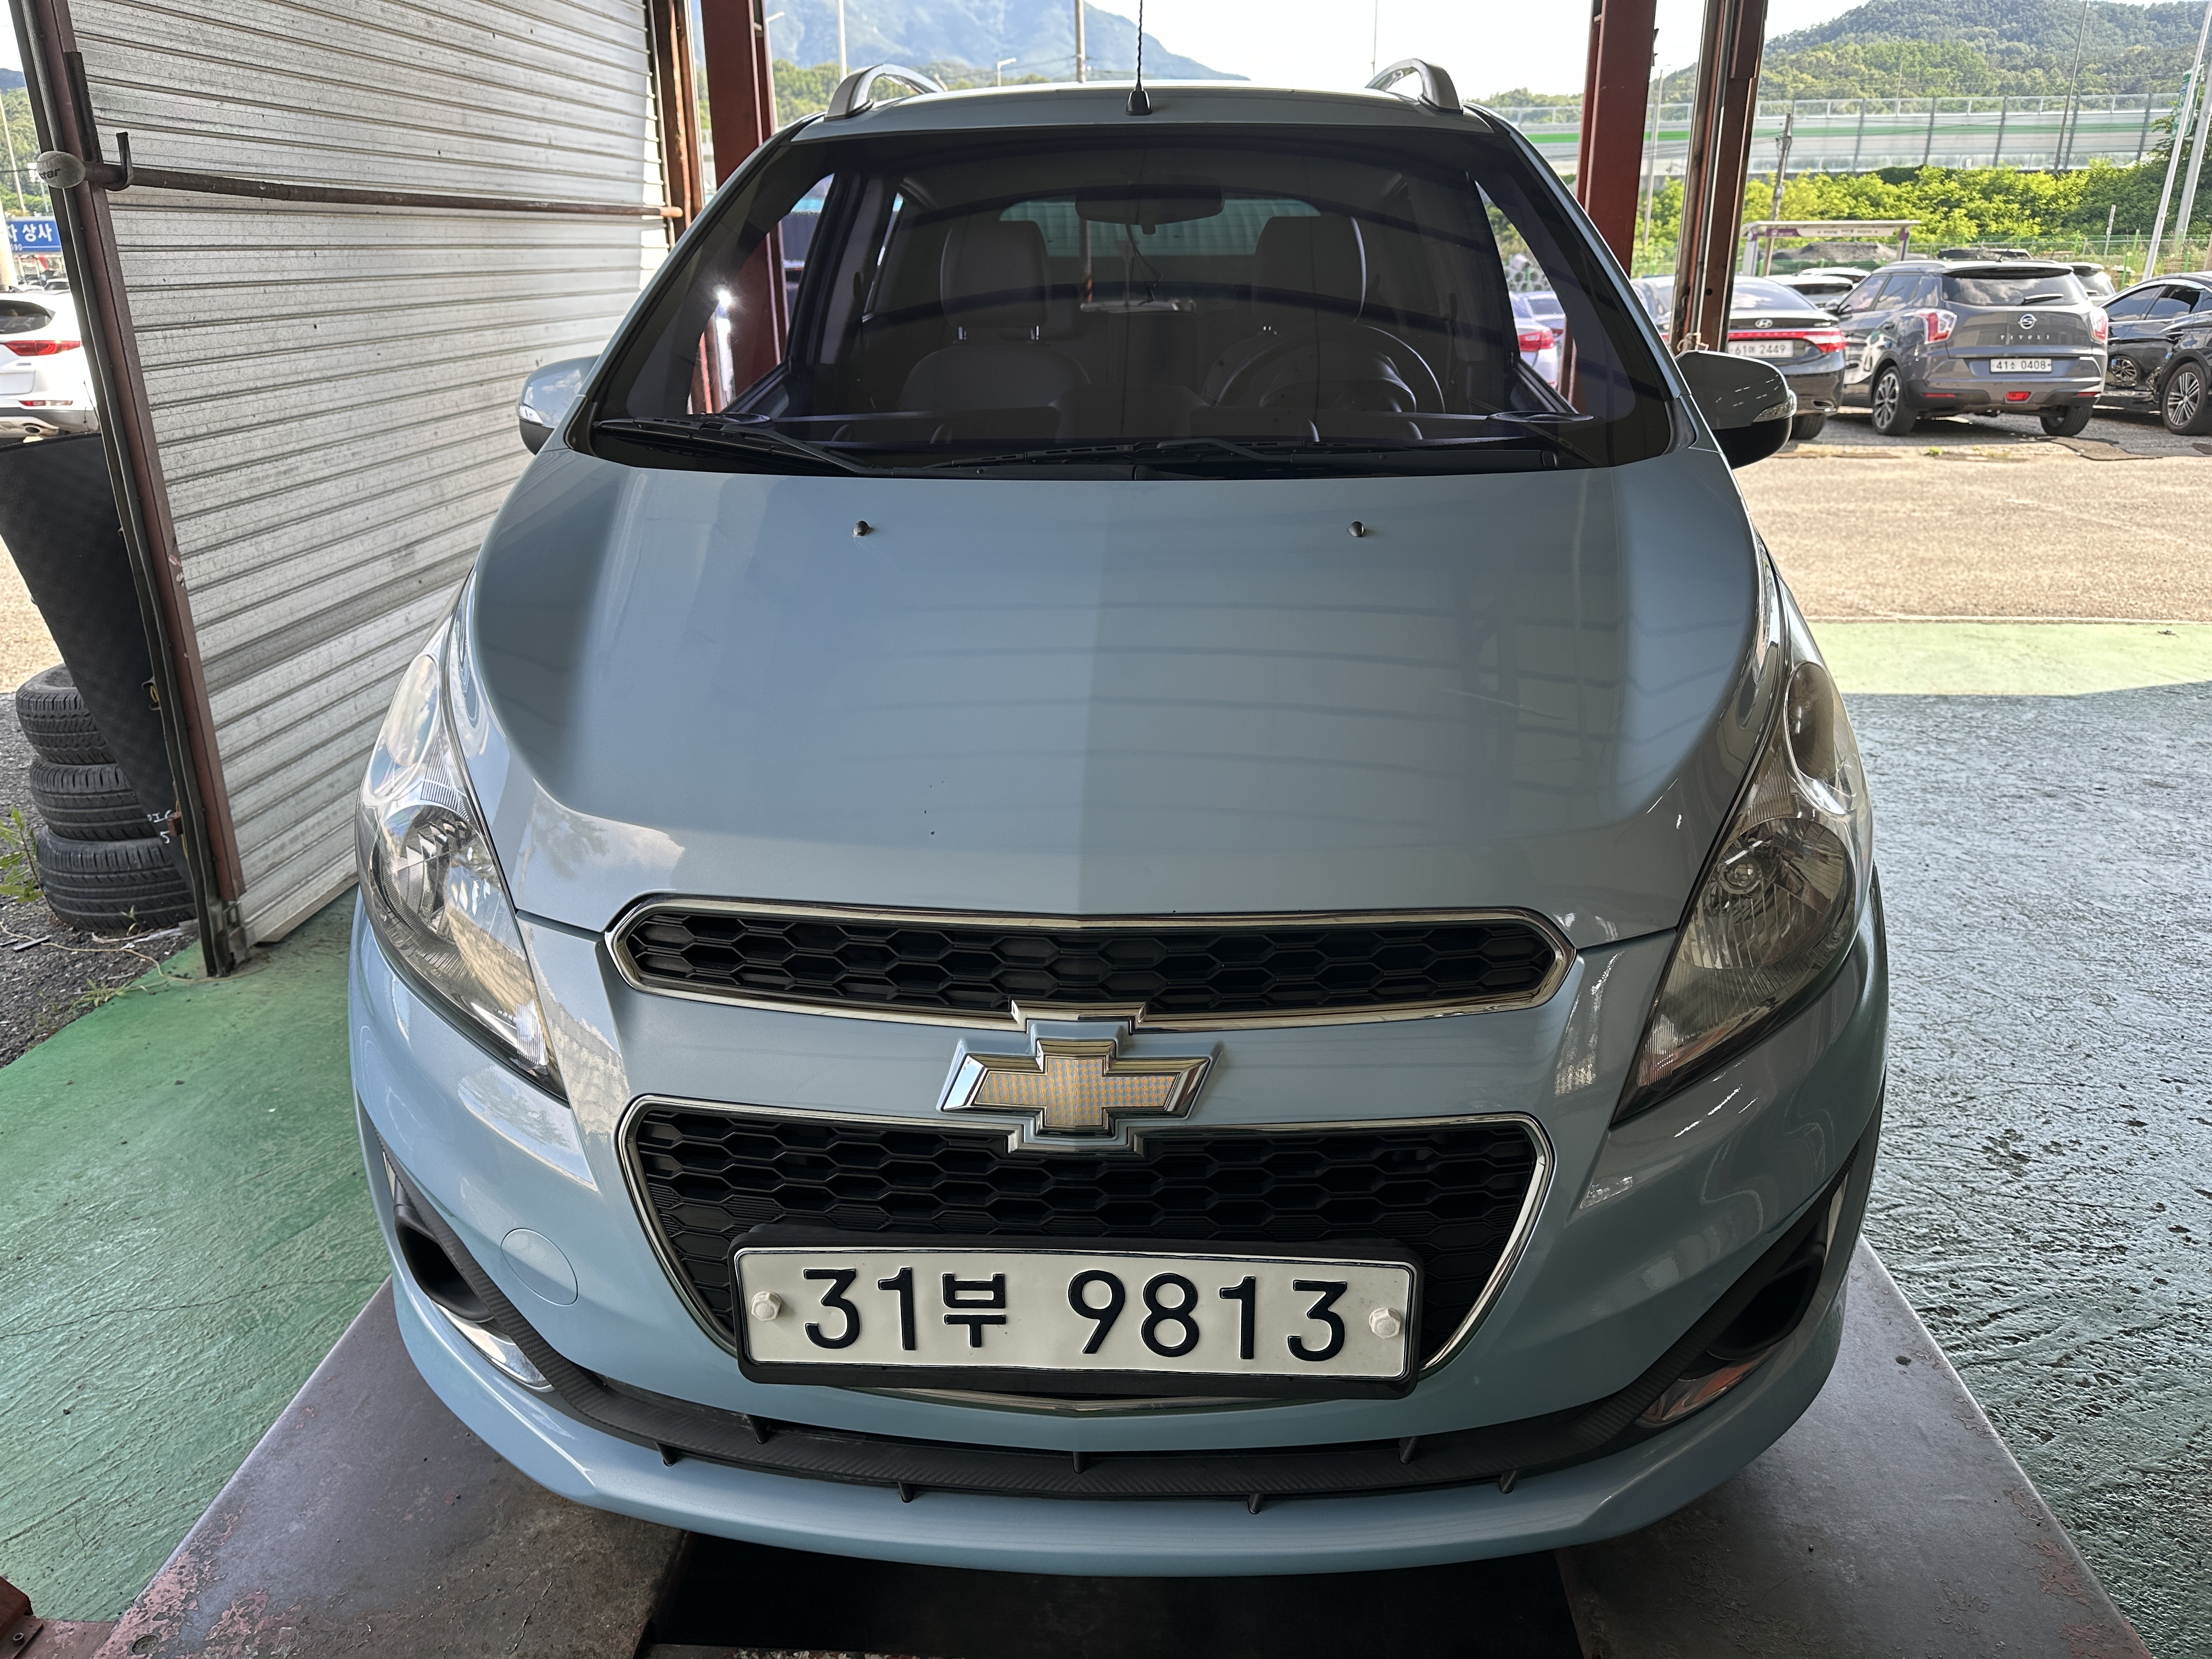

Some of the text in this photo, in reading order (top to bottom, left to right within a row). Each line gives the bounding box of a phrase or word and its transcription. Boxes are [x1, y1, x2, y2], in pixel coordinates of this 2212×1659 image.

[22, 223, 53, 242] 상사
[1760, 345, 1786, 354] 2449
[2021, 360, 2046, 370] 0408
[804, 1267, 1348, 1362] 31부 9813
